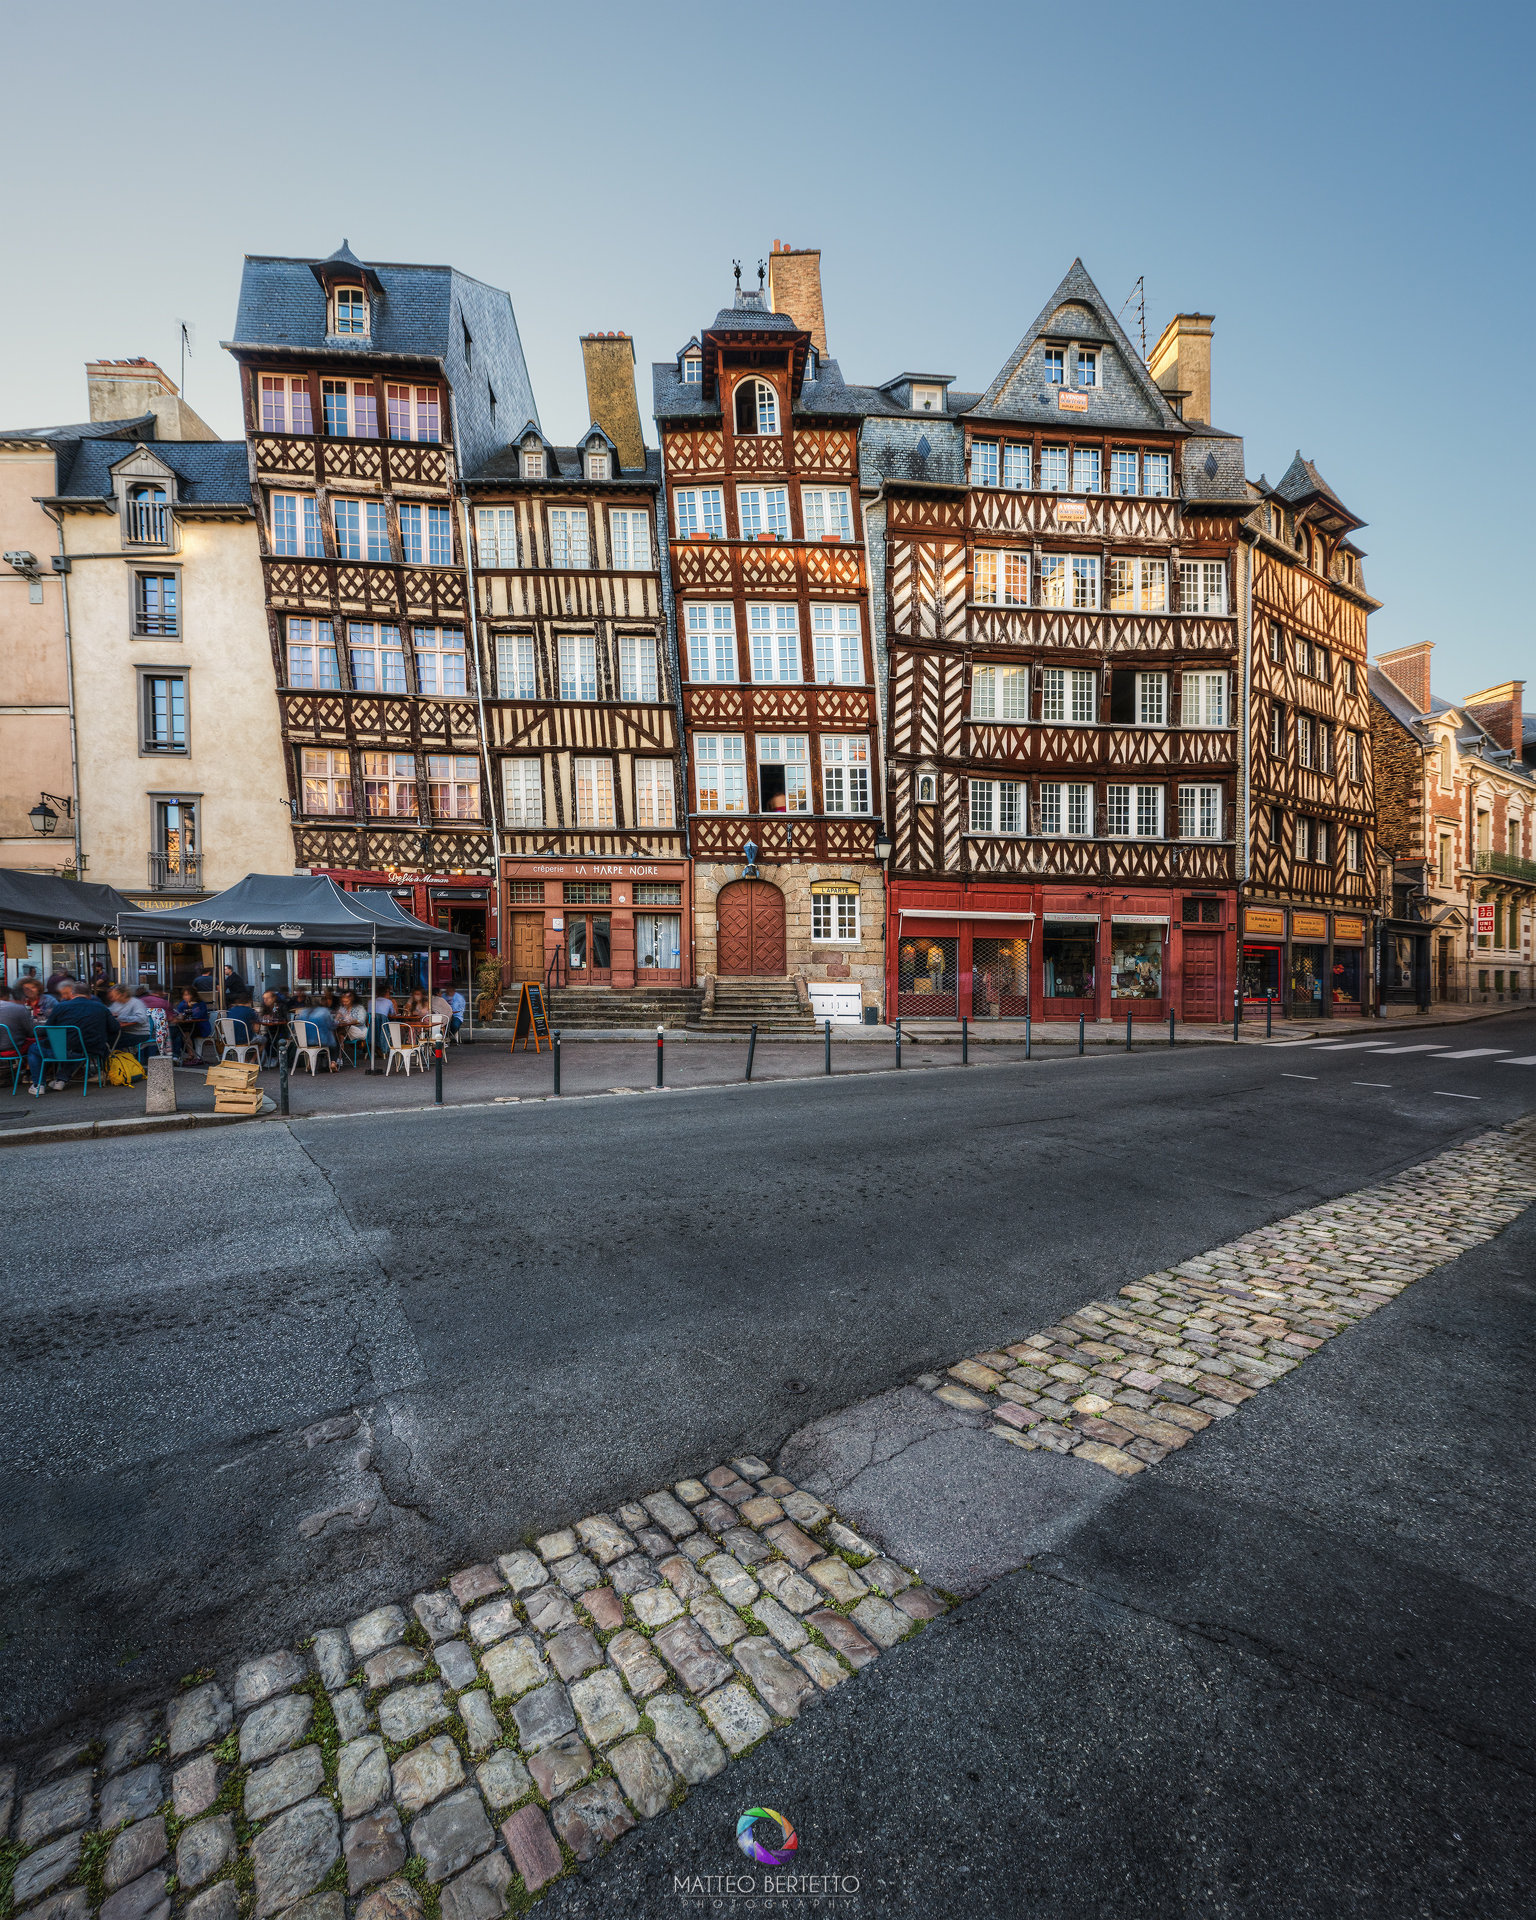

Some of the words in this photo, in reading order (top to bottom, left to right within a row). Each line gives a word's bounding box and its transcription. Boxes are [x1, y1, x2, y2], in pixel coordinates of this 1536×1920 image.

[533, 865, 564, 873] crêperie
[575, 865, 587, 875] LA
[593, 865, 623, 875] HARPE
[629, 866, 658, 875] NOIRE
[419, 874, 449, 883] Maman
[58, 921, 80, 931] BAR
[189, 919, 210, 932] Les
[237, 924, 275, 935] Maman
